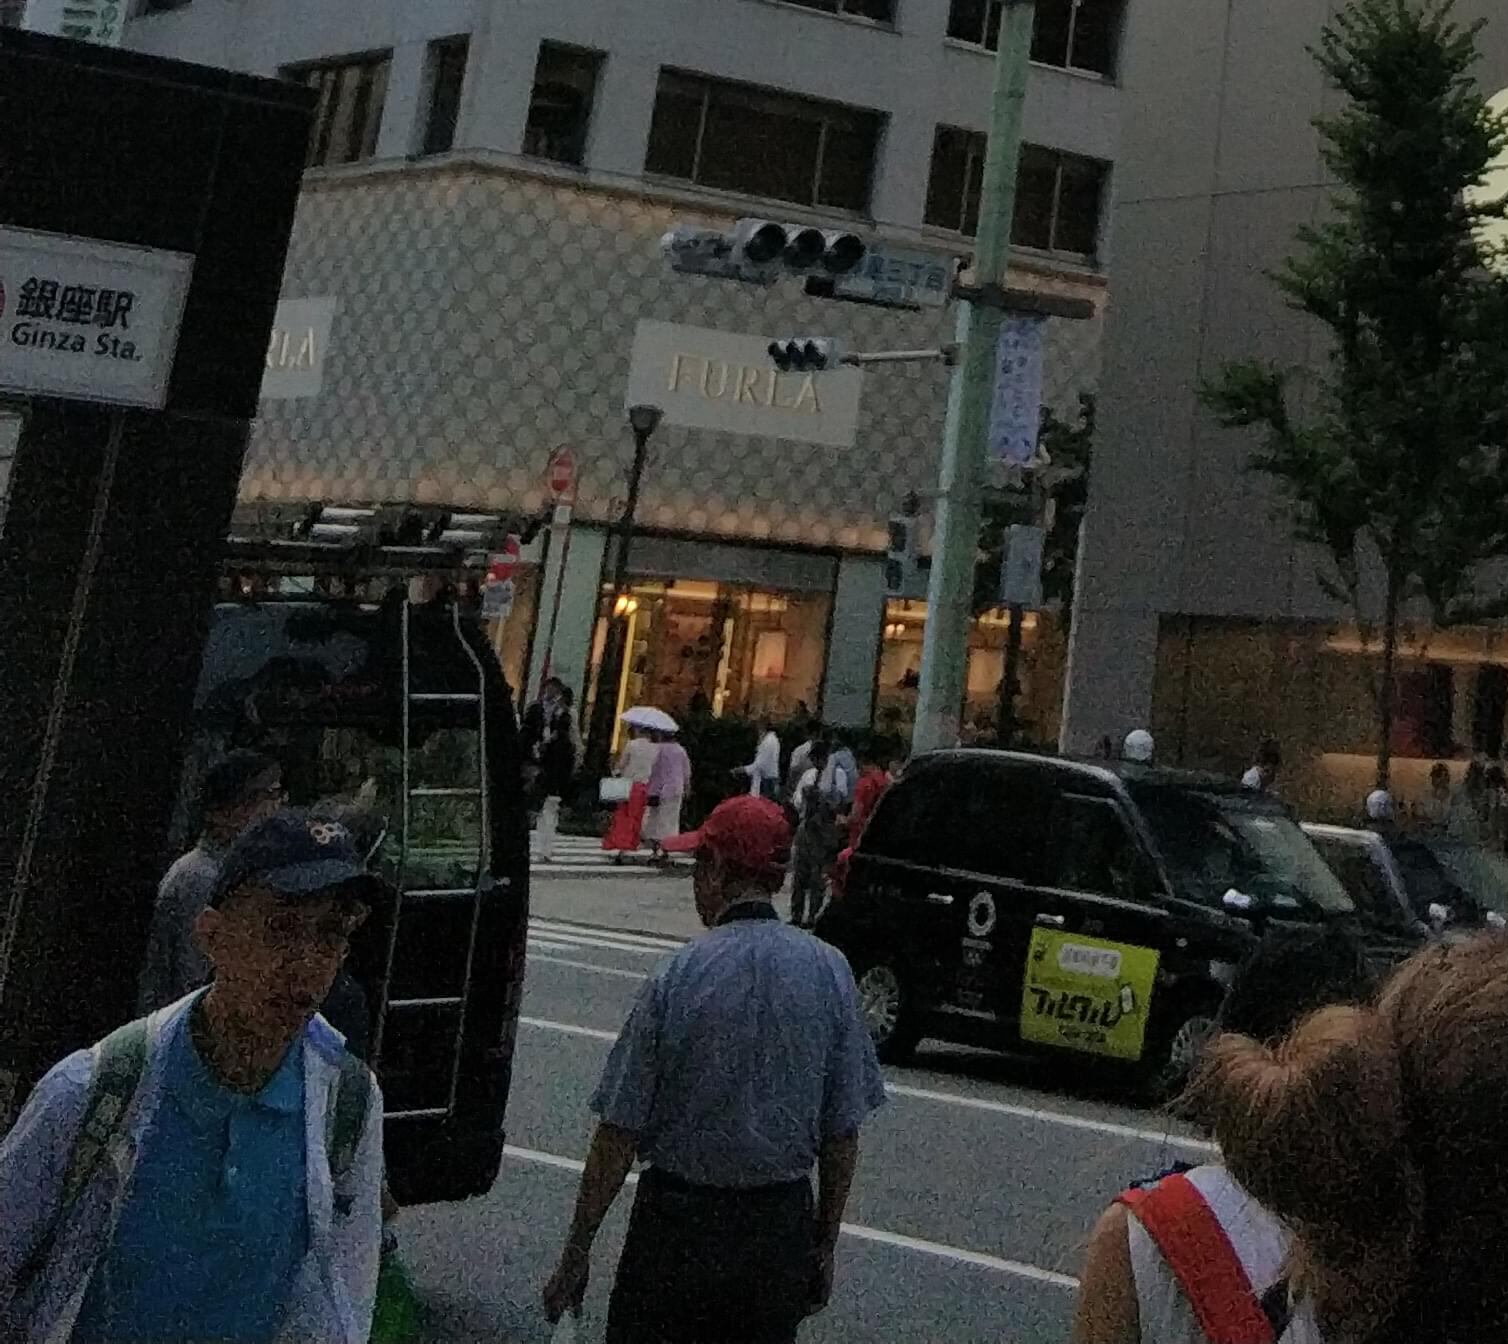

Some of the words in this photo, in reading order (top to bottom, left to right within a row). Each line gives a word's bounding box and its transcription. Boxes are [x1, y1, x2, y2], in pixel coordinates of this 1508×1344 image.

[15, 276, 135, 329] 銀座駅
[11, 321, 86, 353] Ginza
[94, 332, 143, 362] Sta.
[666, 351, 822, 415] FURLA
